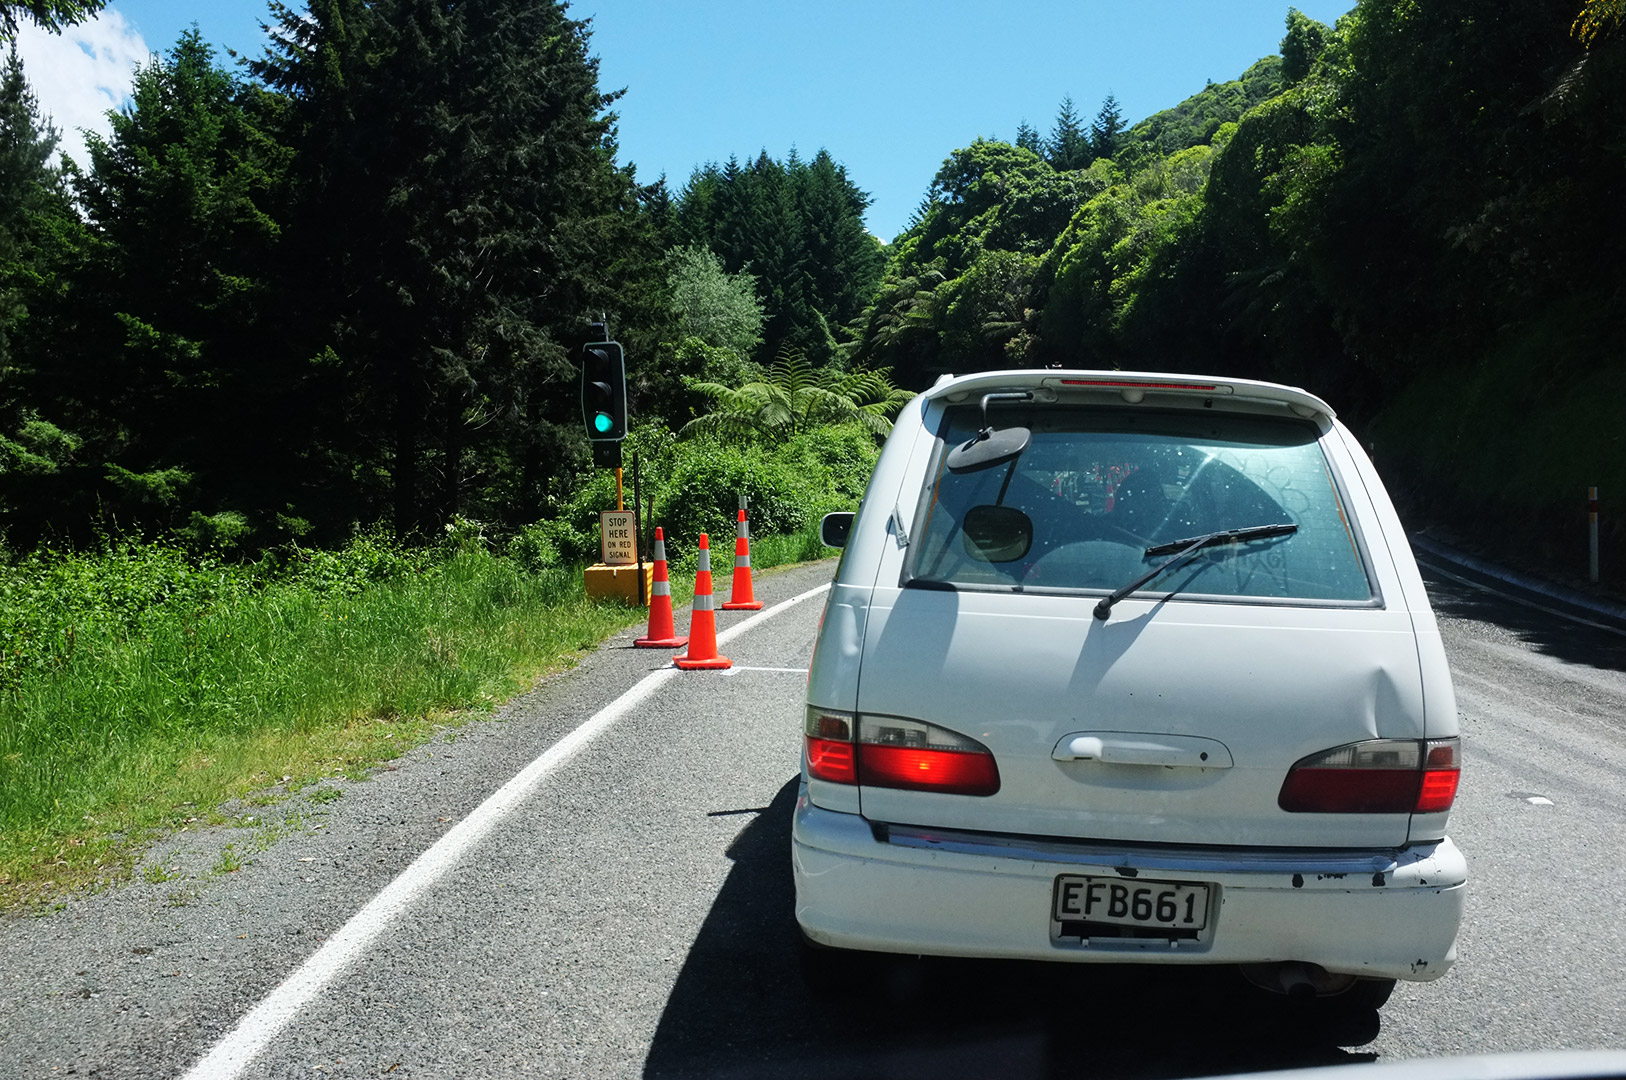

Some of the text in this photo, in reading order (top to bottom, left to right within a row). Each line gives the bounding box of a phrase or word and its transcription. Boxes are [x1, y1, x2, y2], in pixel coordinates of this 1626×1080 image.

[609, 518, 627, 526] STOP
[609, 529, 628, 538] HERE
[1061, 882, 1195, 924] EFB661
